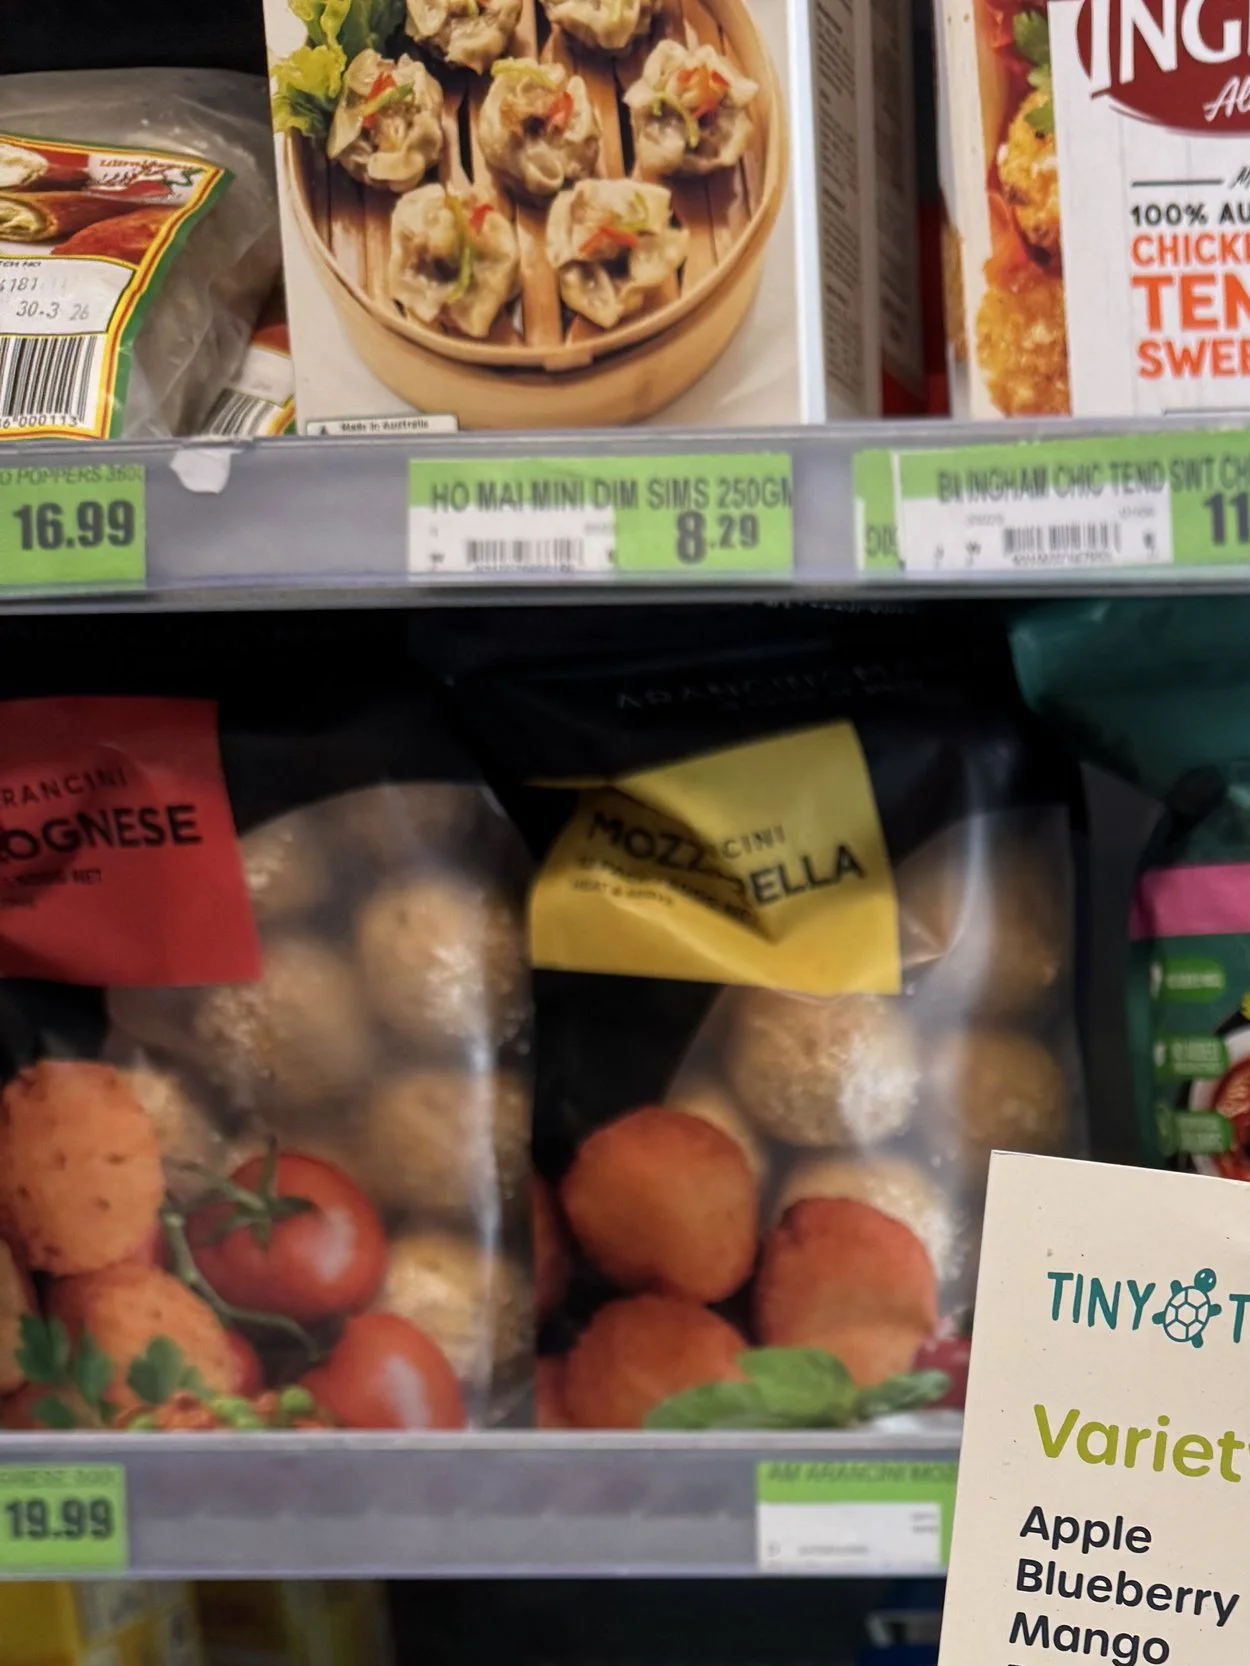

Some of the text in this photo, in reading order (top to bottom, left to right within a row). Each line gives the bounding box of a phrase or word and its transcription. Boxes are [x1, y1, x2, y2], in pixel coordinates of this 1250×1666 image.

[1130, 204, 1208, 227] 100%
[431, 482, 470, 513] HO
[476, 480, 523, 513] MAI
[531, 480, 585, 512] MINI
[594, 478, 639, 511] DIM
[646, 476, 710, 511] SIMS
[966, 464, 1048, 502] INGHAM
[1109, 460, 1167, 495] TEND
[12, 499, 136, 552] 16.99
[675, 510, 760, 565] 8.29
[0, 767, 128, 809] RANCINI
[0, 804, 204, 862] OGNESE
[1046, 1270, 1156, 1331] TINY
[5, 1496, 115, 1541] 19.99
[1018, 1505, 1153, 1555] Apple
[1015, 1558, 1240, 1627] Blueberry
